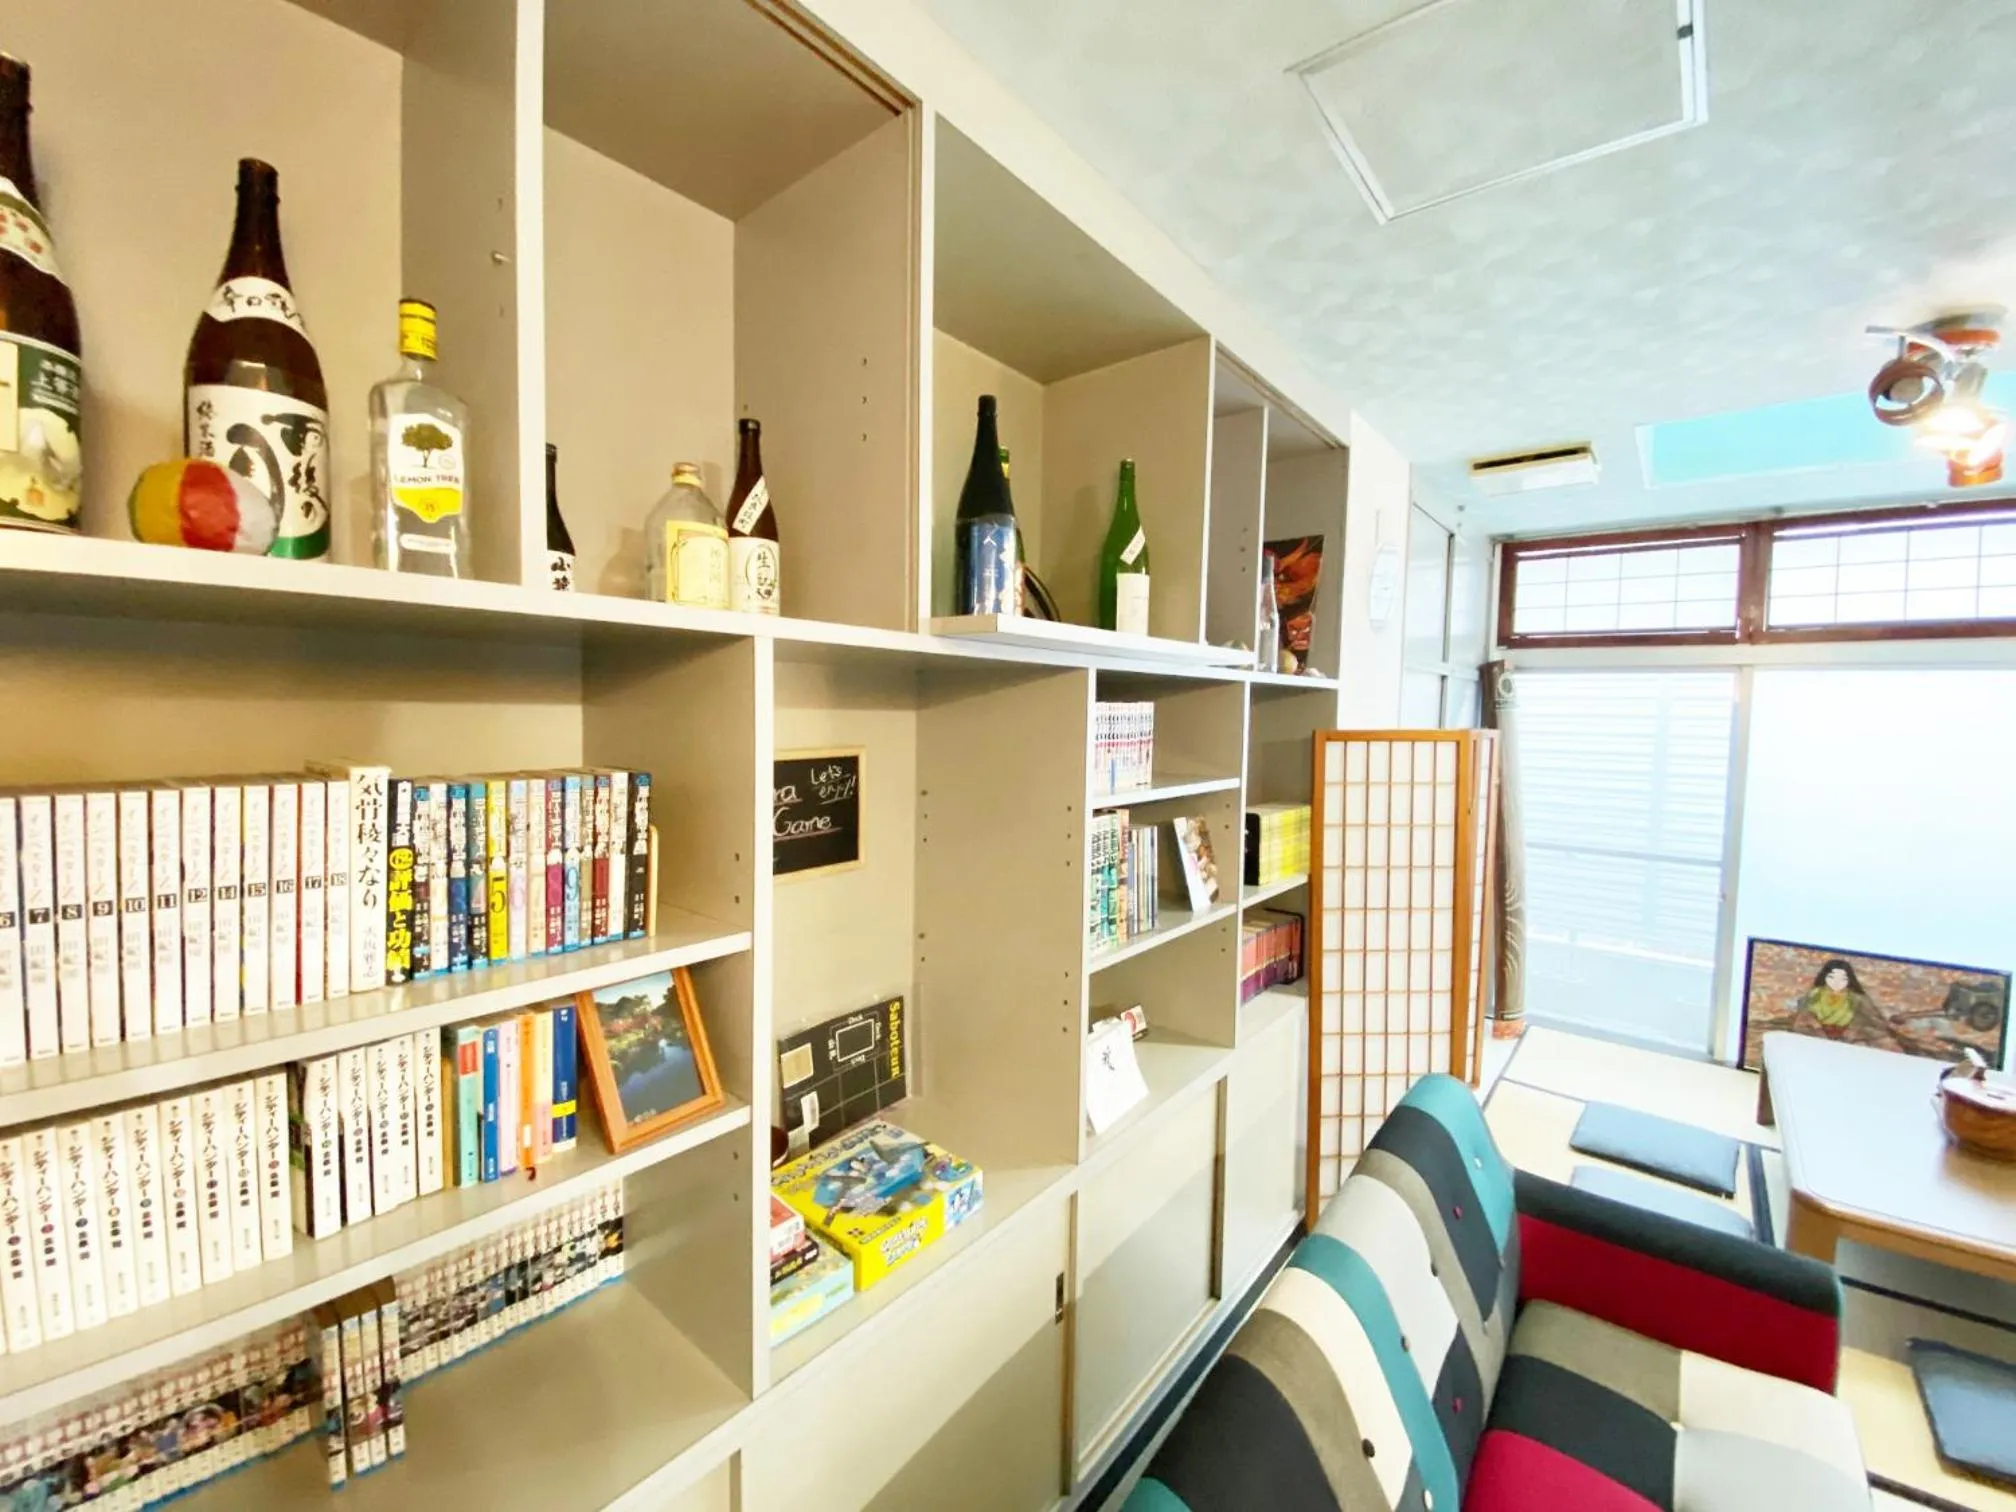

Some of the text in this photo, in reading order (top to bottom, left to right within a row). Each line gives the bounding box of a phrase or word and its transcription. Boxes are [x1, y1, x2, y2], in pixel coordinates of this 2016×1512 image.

[394, 473, 460, 485] LEMON TREE
[355, 774, 382, 910] 気骨稜々なり
[491, 876, 506, 914] 5
[567, 866, 579, 902] 9
[888, 1000, 901, 1080] Saboteur
